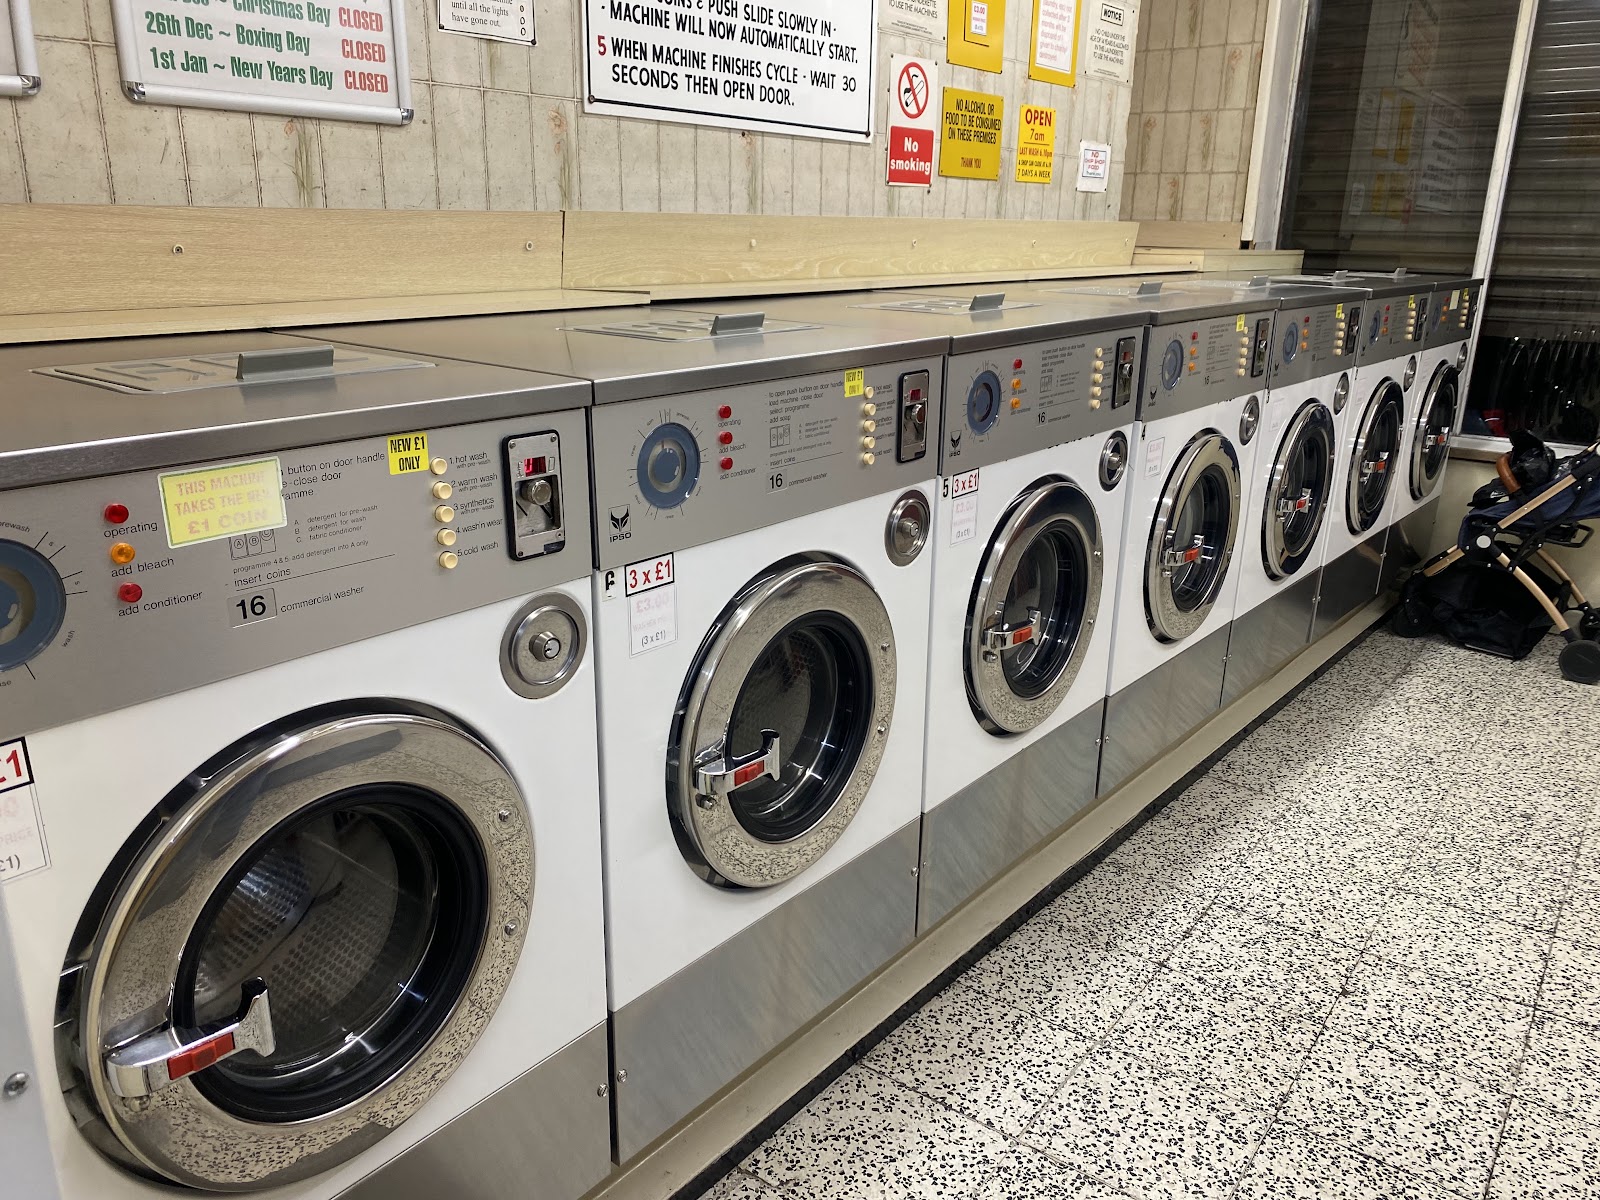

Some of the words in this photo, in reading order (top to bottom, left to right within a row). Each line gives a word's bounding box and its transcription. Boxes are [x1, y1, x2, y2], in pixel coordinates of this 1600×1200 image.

[307, 2, 331, 27] Day
[338, 7, 384, 32] CLOSED
[451, 1, 467, 10] until
[468, 3, 478, 12] all
[479, 4, 491, 13] the
[492, 5, 509, 16] lights
[708, 0, 738, 18] PUSH
[743, 3, 774, 26] SLIDE
[778, 11, 818, 34] SLOWLY
[896, 1, 904, 10] USE
[905, 3, 914, 12] THE
[914, 6, 938, 19] MACHINES
[1103, 8, 1122, 21] NOTICE
[451, 12, 469, 23] have
[470, 17, 488, 26] gone
[144, 10, 182, 37] 26th
[184, 16, 214, 41] Dec
[235, 23, 283, 53] Boxing
[286, 31, 310, 56] Day
[341, 38, 386, 63] CLOSED
[610, 0, 670, 29] MACHINE
[675, 12, 705, 36] WILL
[709, 19, 736, 41] NOW
[740, 26, 825, 56] AUTOMATICALLY
[829, 43, 858, 63] START.
[149, 46, 175, 70] 1st
[180, 51, 208, 74] Jan
[230, 56, 262, 80] New
[266, 60, 306, 84] Years
[310, 65, 333, 90] Day
[344, 69, 389, 93] CLOSED
[597, 35, 607, 56] 5
[611, 36, 648, 62] WHEN
[652, 44, 706, 70] MACHINE
[712, 54, 762, 79] FINISHES
[766, 63, 798, 84] CYCLE
[810, 70, 836, 89] WAIT
[842, 76, 857, 92] 30
[612, 63, 678, 91] SECONDS
[685, 74, 718, 96] THEN
[723, 80, 755, 101] OPEN
[760, 85, 795, 106] DOOR.
[956, 98, 964, 111] NO
[964, 100, 986, 114] ALCOHOL
[987, 103, 995, 116] OR
[945, 112, 959, 126] FOOD
[960, 114, 967, 126] TO
[968, 115, 975, 127] BE
[975, 116, 1002, 131] CONSUMED
[1025, 108, 1052, 127] OPEN
[948, 127, 956, 139] ON
[957, 128, 972, 142] THESE
[973, 130, 997, 144] PREMISES
[1029, 128, 1045, 141] 7am
[904, 137, 919, 152] No
[890, 157, 931, 175] smoking
[961, 157, 973, 168] THANK
[974, 158, 982, 168] YOU
[1017, 168, 1021, 176] 7
[1021, 169, 1033, 177] DAYS
[1034, 169, 1038, 177] A
[1039, 170, 1051, 178] WEEK
[717, 418, 742, 429] operating
[390, 439, 411, 454] NEW
[414, 436, 425, 450] £1
[287, 462, 317, 475] button
[319, 461, 331, 470] on
[333, 457, 354, 468] door
[356, 452, 385, 465] handle
[399, 456, 421, 471] ONLY
[469, 451, 488, 462] wash
[321, 471, 342, 482] door
[479, 473, 498, 484] wash
[770, 473, 783, 489] 16
[943, 478, 949, 498] 5
[954, 478, 960, 493] 3
[961, 479, 966, 491] x
[968, 472, 978, 489] £1
[176, 480, 206, 497] THIS
[174, 497, 216, 516] TAKES
[221, 493, 243, 509] THE
[307, 512, 337, 524] detergent
[339, 510, 347, 518] for
[308, 520, 338, 533] detergent
[340, 518, 348, 526] for
[350, 515, 366, 525] wash
[487, 518, 503, 531] wear
[103, 521, 158, 539] operating
[187, 519, 210, 534] £1
[309, 532, 328, 542] fabric
[328, 524, 363, 538] conditioner
[481, 541, 499, 551] wash
[609, 532, 632, 543] IPSO
[233, 560, 272, 575] programme
[291, 552, 305, 561] add
[306, 547, 336, 560] detergent
[337, 544, 350, 553] into
[356, 539, 369, 549] only
[111, 565, 133, 578] add
[137, 557, 175, 573] bleach
[629, 569, 638, 589] 3
[642, 570, 651, 585] x
[655, 559, 671, 580] £1
[234, 574, 262, 588] insert
[266, 567, 291, 580] coins
[118, 605, 140, 618] add
[143, 590, 203, 611] conditioner
[235, 595, 267, 620] 16
[280, 592, 332, 613] commercial
[334, 584, 364, 599] washer
[62, 629, 75, 648] wash
[641, 636, 648, 648] (3
[655, 630, 667, 642] £1)
